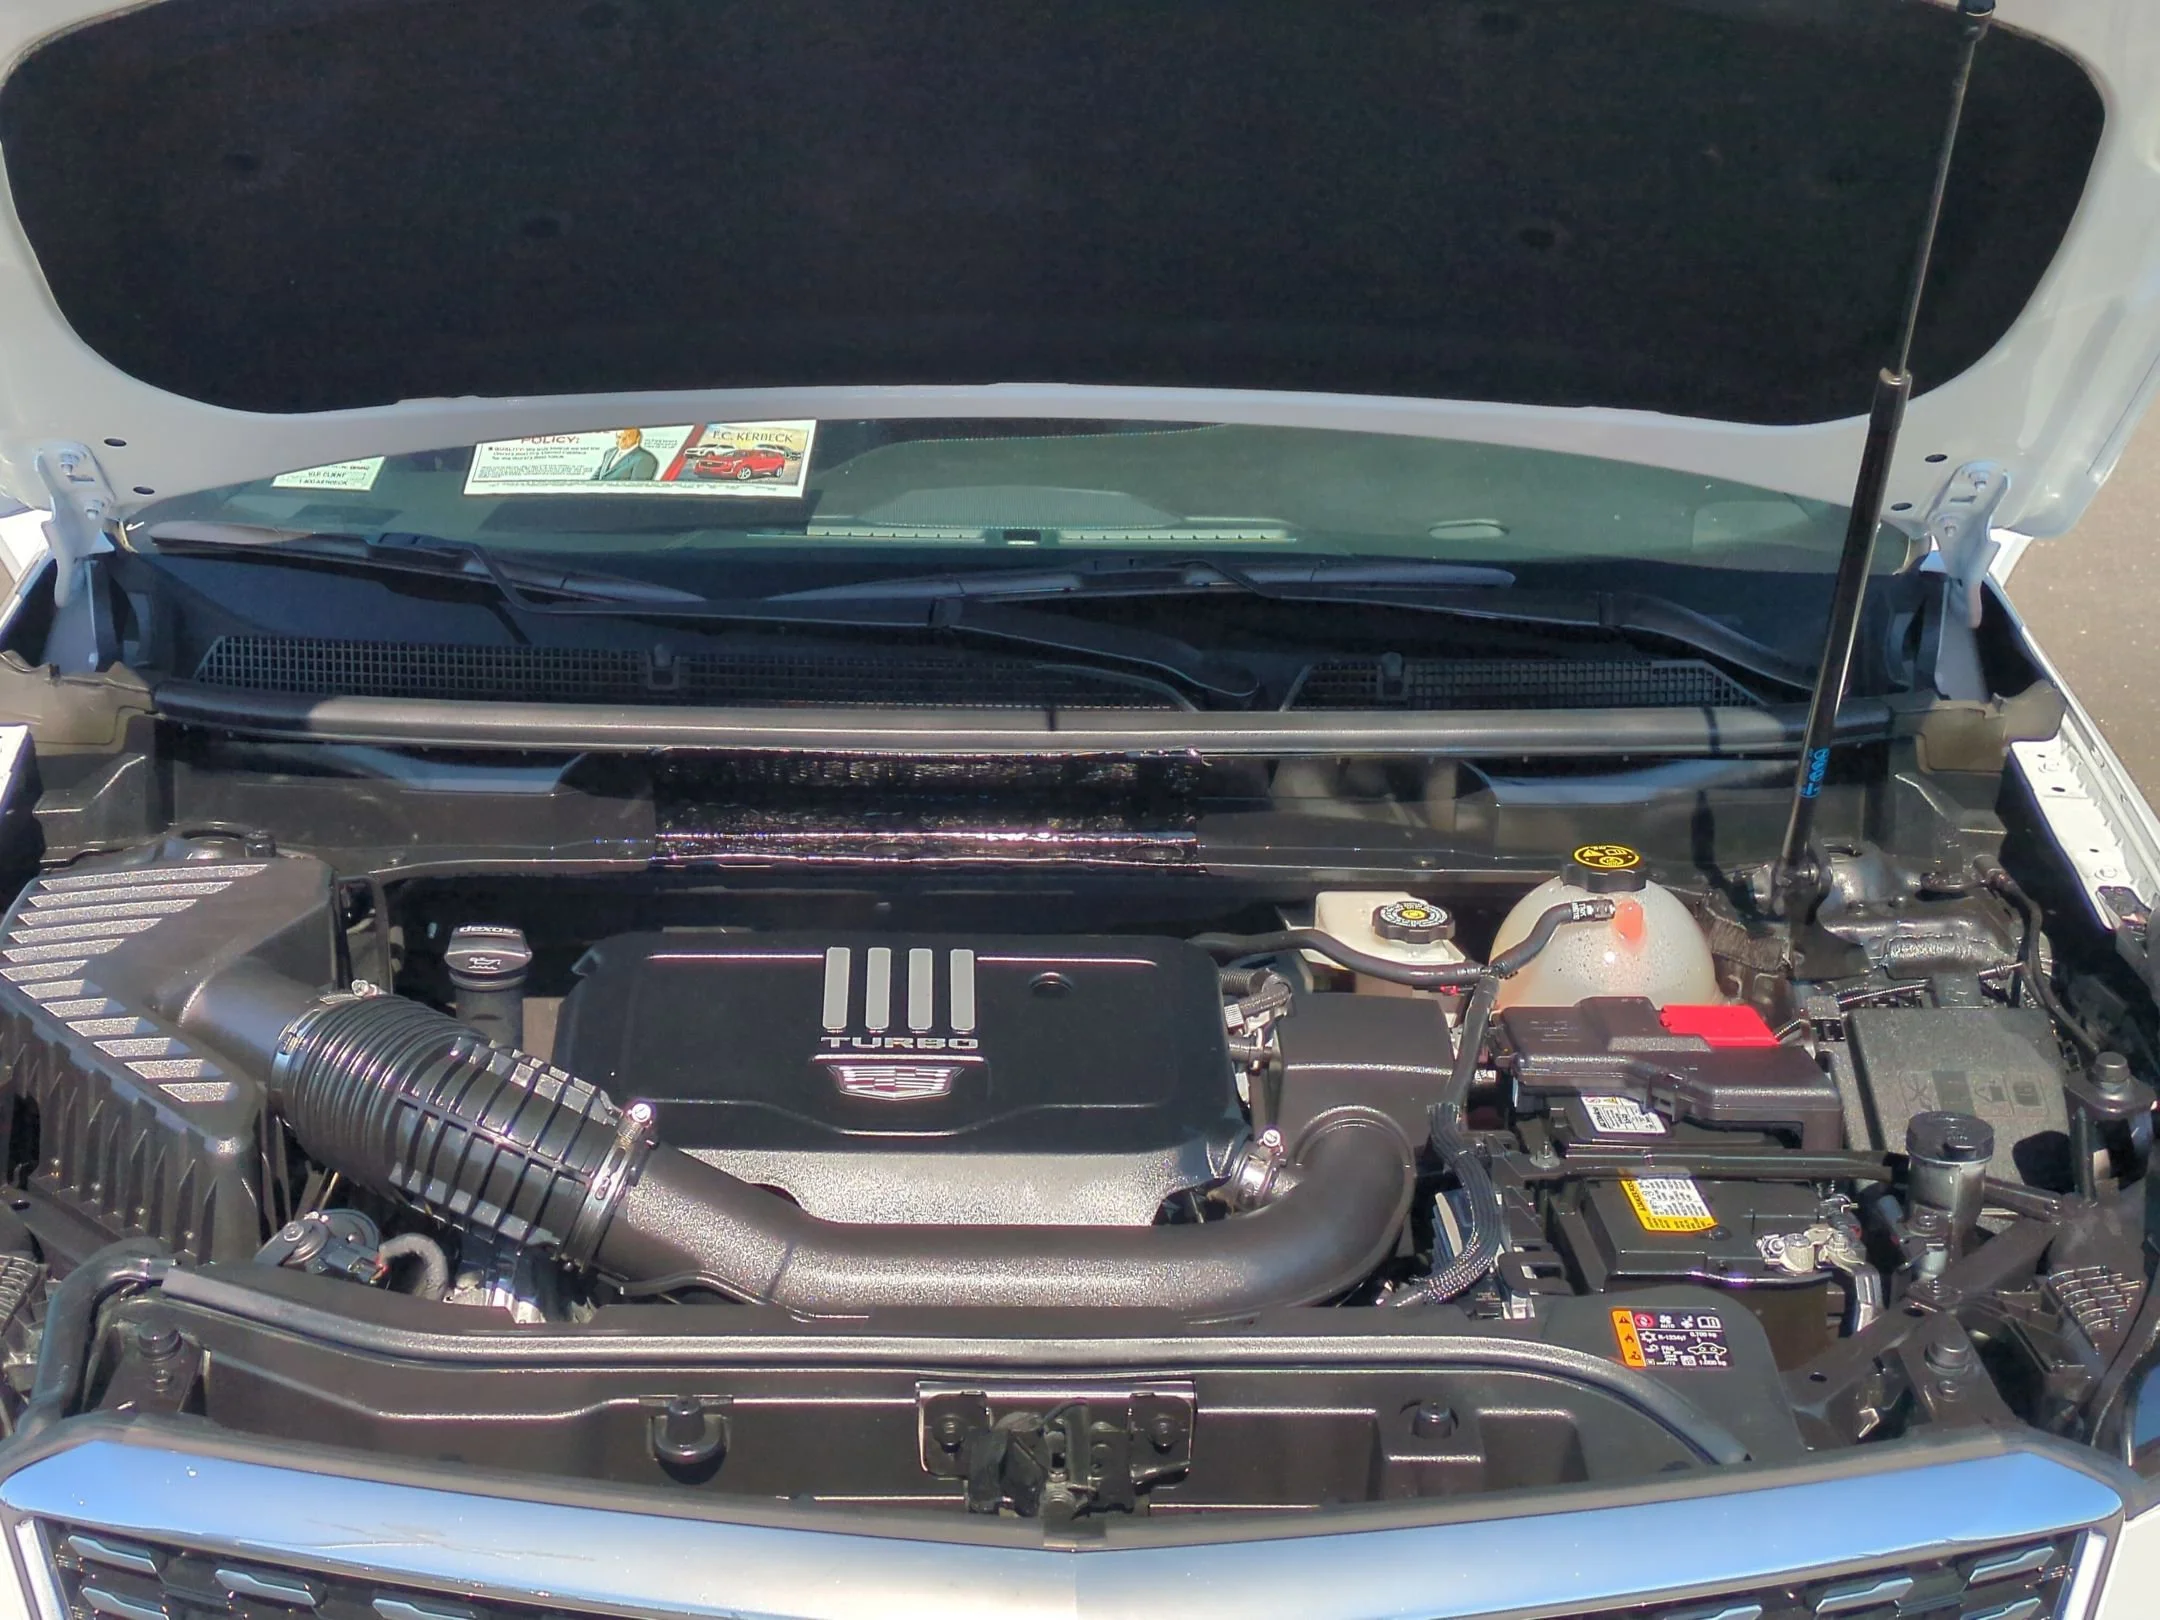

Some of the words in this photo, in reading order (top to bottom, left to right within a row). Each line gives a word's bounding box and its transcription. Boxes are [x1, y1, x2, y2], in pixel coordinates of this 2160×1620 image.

[737, 431, 793, 443] KERBECK
[459, 925, 516, 934] dexos
[820, 1037, 979, 1050] TURBO
